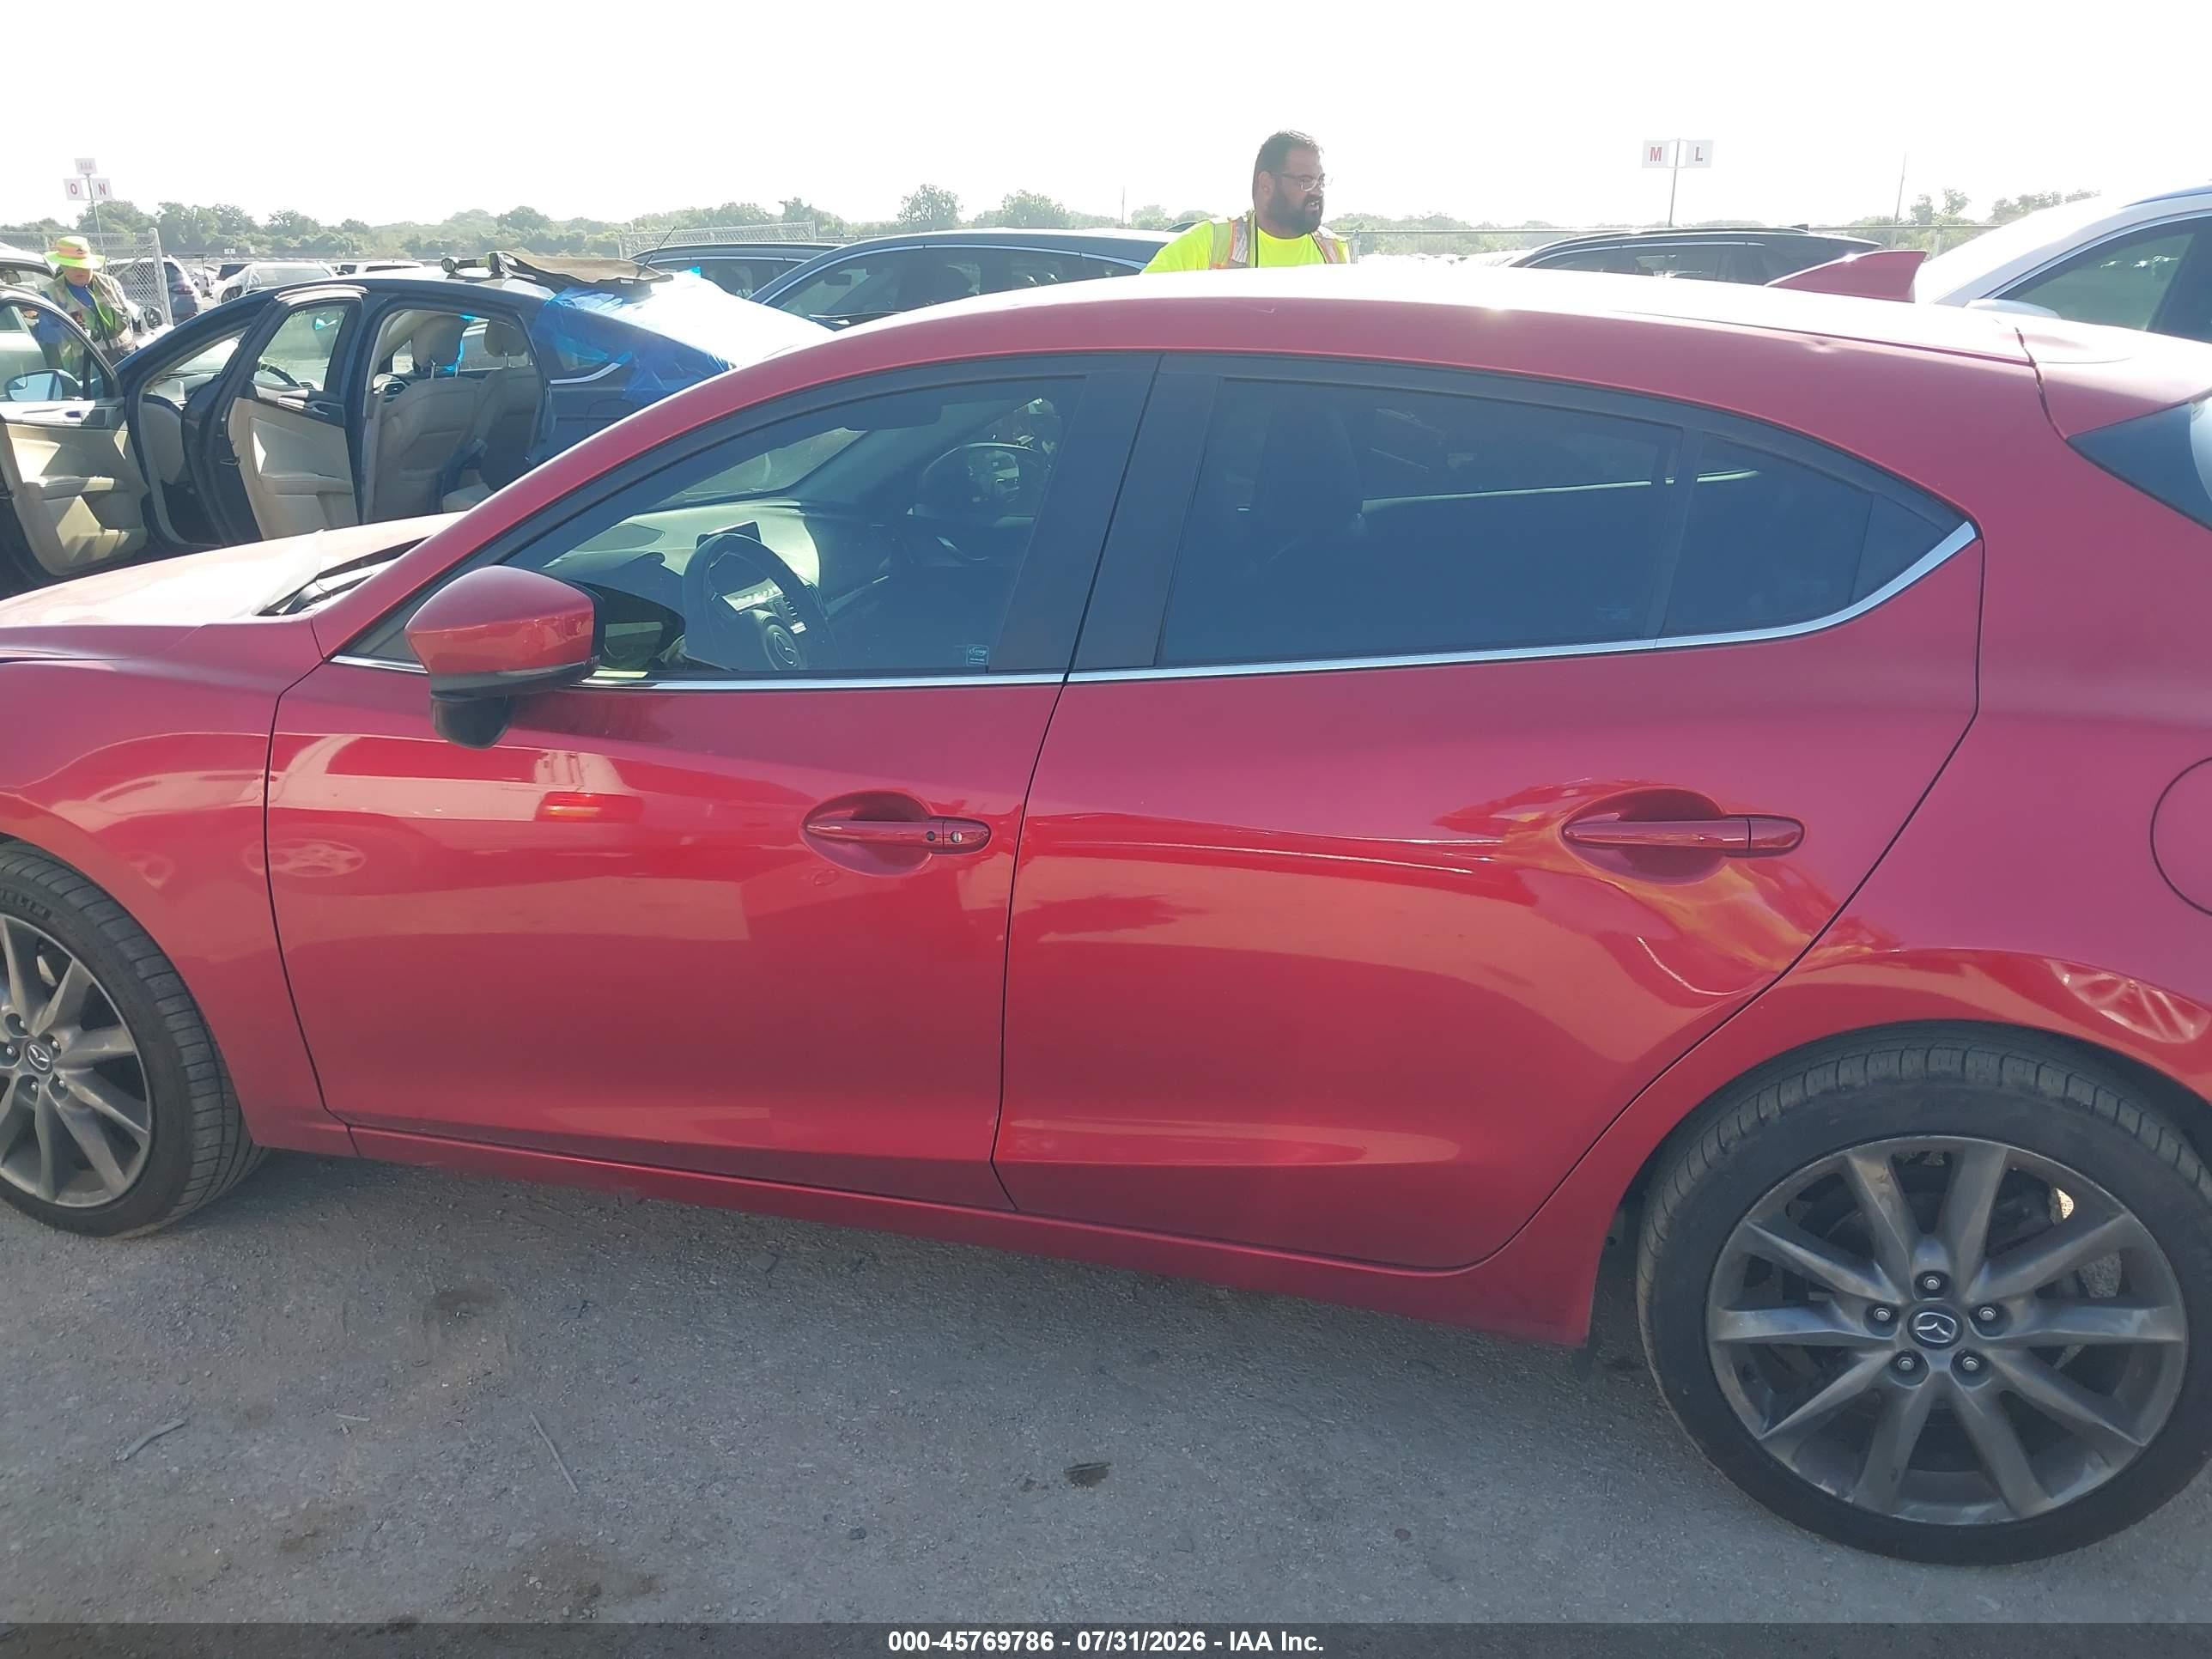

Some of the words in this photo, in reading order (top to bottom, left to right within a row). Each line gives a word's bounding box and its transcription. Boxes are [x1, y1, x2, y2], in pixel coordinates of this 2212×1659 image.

[1650, 146, 1662, 161] M
[1695, 146, 1703, 161] L
[98, 183, 106, 195] N
